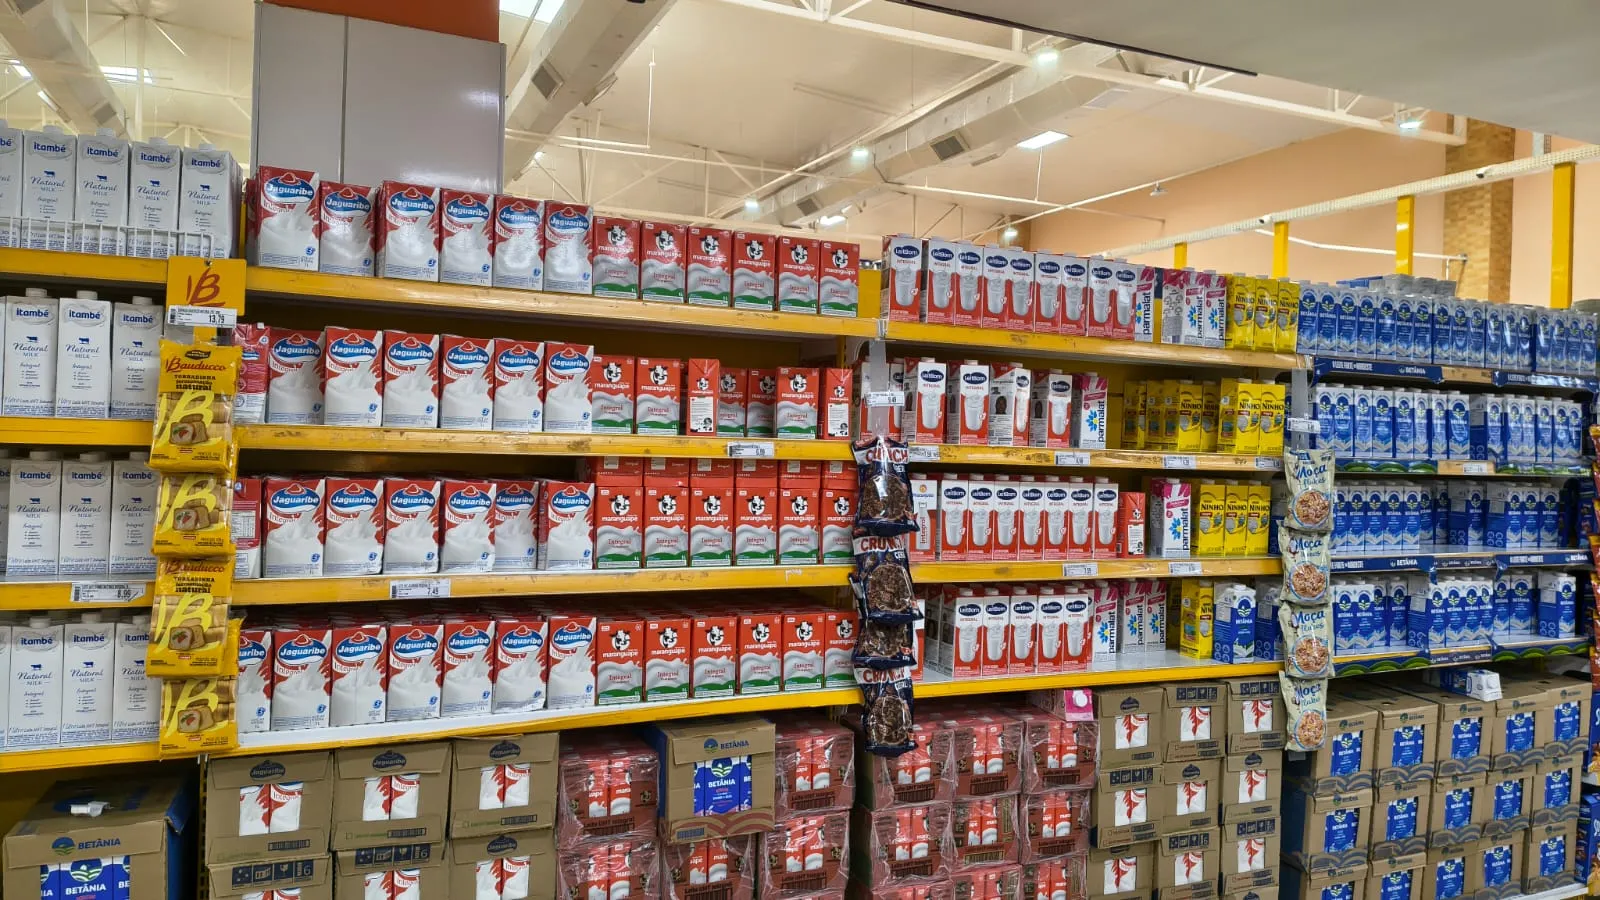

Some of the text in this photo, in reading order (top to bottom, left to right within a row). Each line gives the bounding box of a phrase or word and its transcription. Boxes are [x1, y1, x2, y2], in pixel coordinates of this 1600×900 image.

[34, 142, 66, 153] itambé
[87, 146, 118, 158] itambé
[140, 152, 170, 163] itambé
[191, 158, 220, 168] itambé
[268, 184, 313, 196] Jaguaribe
[326, 198, 369, 209] Jaguaribe
[392, 198, 434, 209] Jaguaribe
[448, 207, 488, 217] Jaguaribe
[501, 212, 539, 222] Jaguaribe
[551, 217, 588, 227] Jaguaribe
[646, 250, 682, 258] maranguape
[738, 259, 770, 267] maranguape
[1280, 300, 1298, 308] NINHO
[16, 307, 48, 318] itambé
[69, 310, 100, 319] itambé
[1143, 292, 1151, 335] parmalat
[123, 314, 153, 324] itambé
[13, 342, 48, 353] Natural
[65, 344, 100, 354] Natural
[274, 345, 320, 354] Jaguaribe
[332, 345, 376, 354] Jaguaribe
[391, 349, 433, 358] Jaguaribe
[449, 353, 488, 362] Jaguaribe
[166, 356, 226, 372] Bauducco
[501, 357, 538, 365] Jaguaribe
[1181, 402, 1202, 410] NINHO
[1240, 402, 1260, 410] NINHO
[20, 471, 51, 480] itambé
[72, 471, 102, 480] itambé
[122, 471, 152, 480] itambé
[1297, 464, 1327, 478] Moça
[273, 496, 318, 504] Jaguaribe
[332, 496, 376, 504] Jaguaribe
[392, 496, 434, 504] Jaguaribe
[451, 498, 490, 506] Jaguaribe
[1295, 539, 1322, 551] Moça
[165, 560, 224, 574] Bauducco
[1295, 610, 1325, 624] Moça
[21, 636, 53, 646] itambé
[73, 634, 105, 644] itambé
[450, 637, 489, 646] Jaguaribe
[504, 637, 541, 646] Jaguaribe
[555, 633, 591, 642] Jaguaribe
[339, 644, 380, 653] Jaguaribe
[396, 640, 437, 650] Jaguaribe
[789, 640, 820, 648] maranguape
[280, 647, 325, 656] Jaguaribe
[602, 650, 638, 658] maranguape
[652, 648, 685, 656] maranguape
[17, 672, 52, 681] Natural
[70, 669, 103, 678] Natural
[1297, 683, 1321, 697] Moça
[721, 740, 748, 750] BETÂNIA
[708, 779, 735, 788] BETÂNIA
[78, 838, 121, 850] BETÂNIA
[65, 883, 106, 895] BETÂNIA
